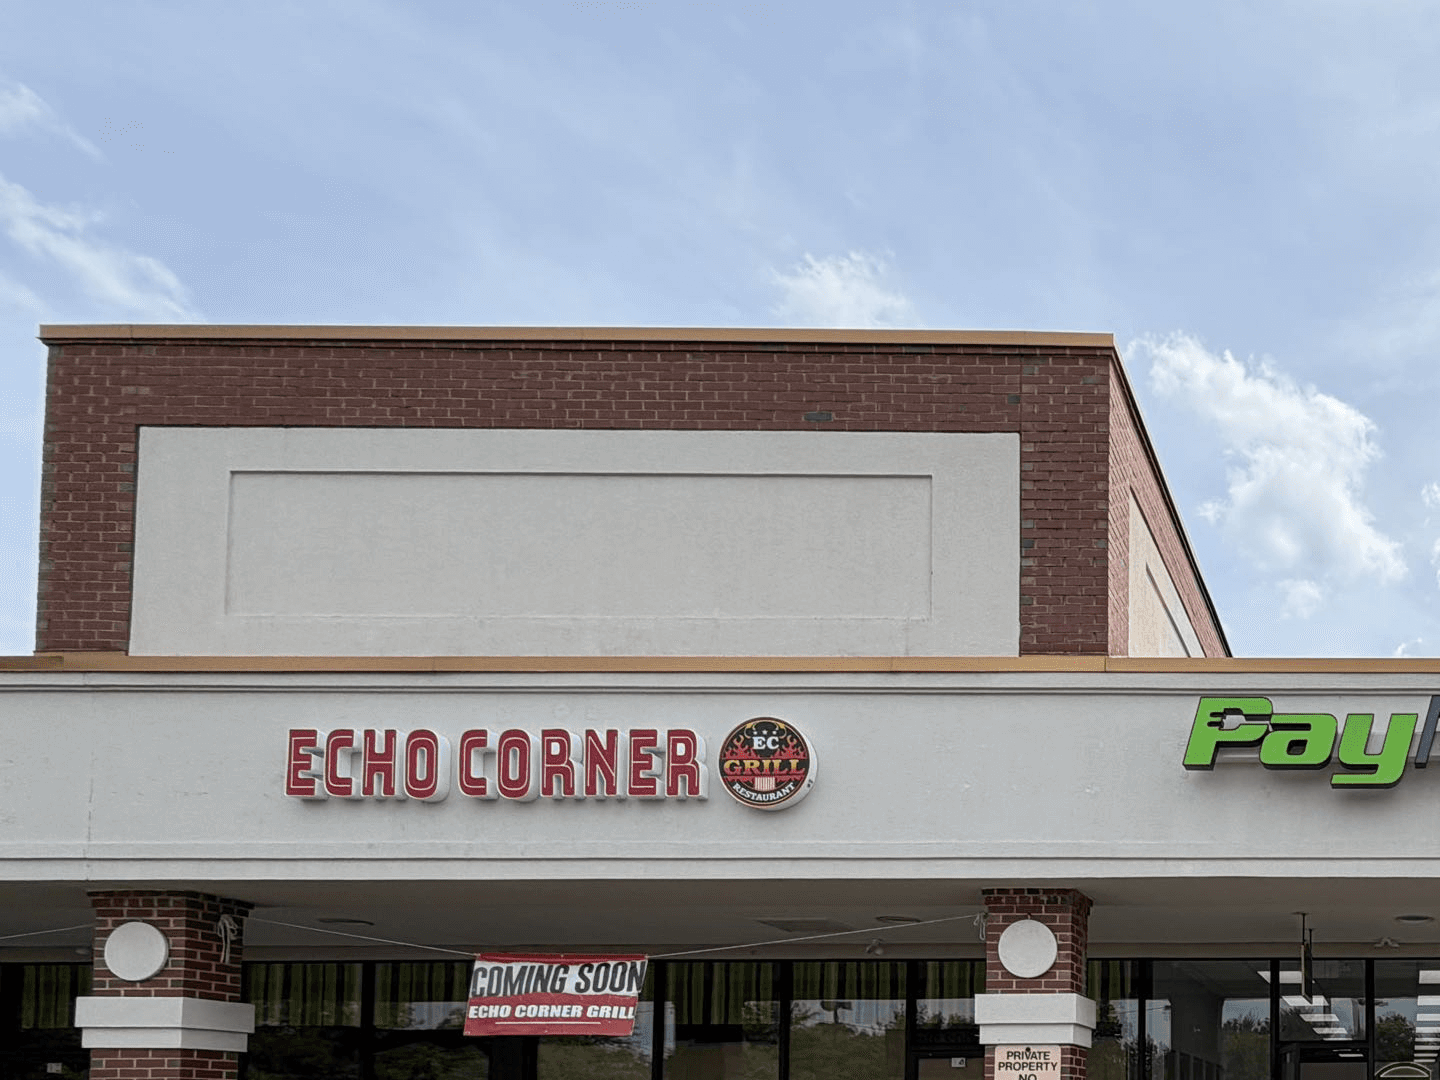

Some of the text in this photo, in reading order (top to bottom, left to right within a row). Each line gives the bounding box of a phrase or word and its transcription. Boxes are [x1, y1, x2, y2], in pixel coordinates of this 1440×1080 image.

[752, 736, 779, 750] EC
[286, 728, 705, 799] ECHO CORNER
[723, 759, 806, 775] GRILL
[732, 782, 796, 802] RESTAURANT
[471, 960, 647, 997] COMING SOON
[468, 1004, 636, 1019] ECHO CORNER GRILL
[1006, 1050, 1051, 1061] PRIVATE
[998, 1061, 1058, 1071] PROPERTY
